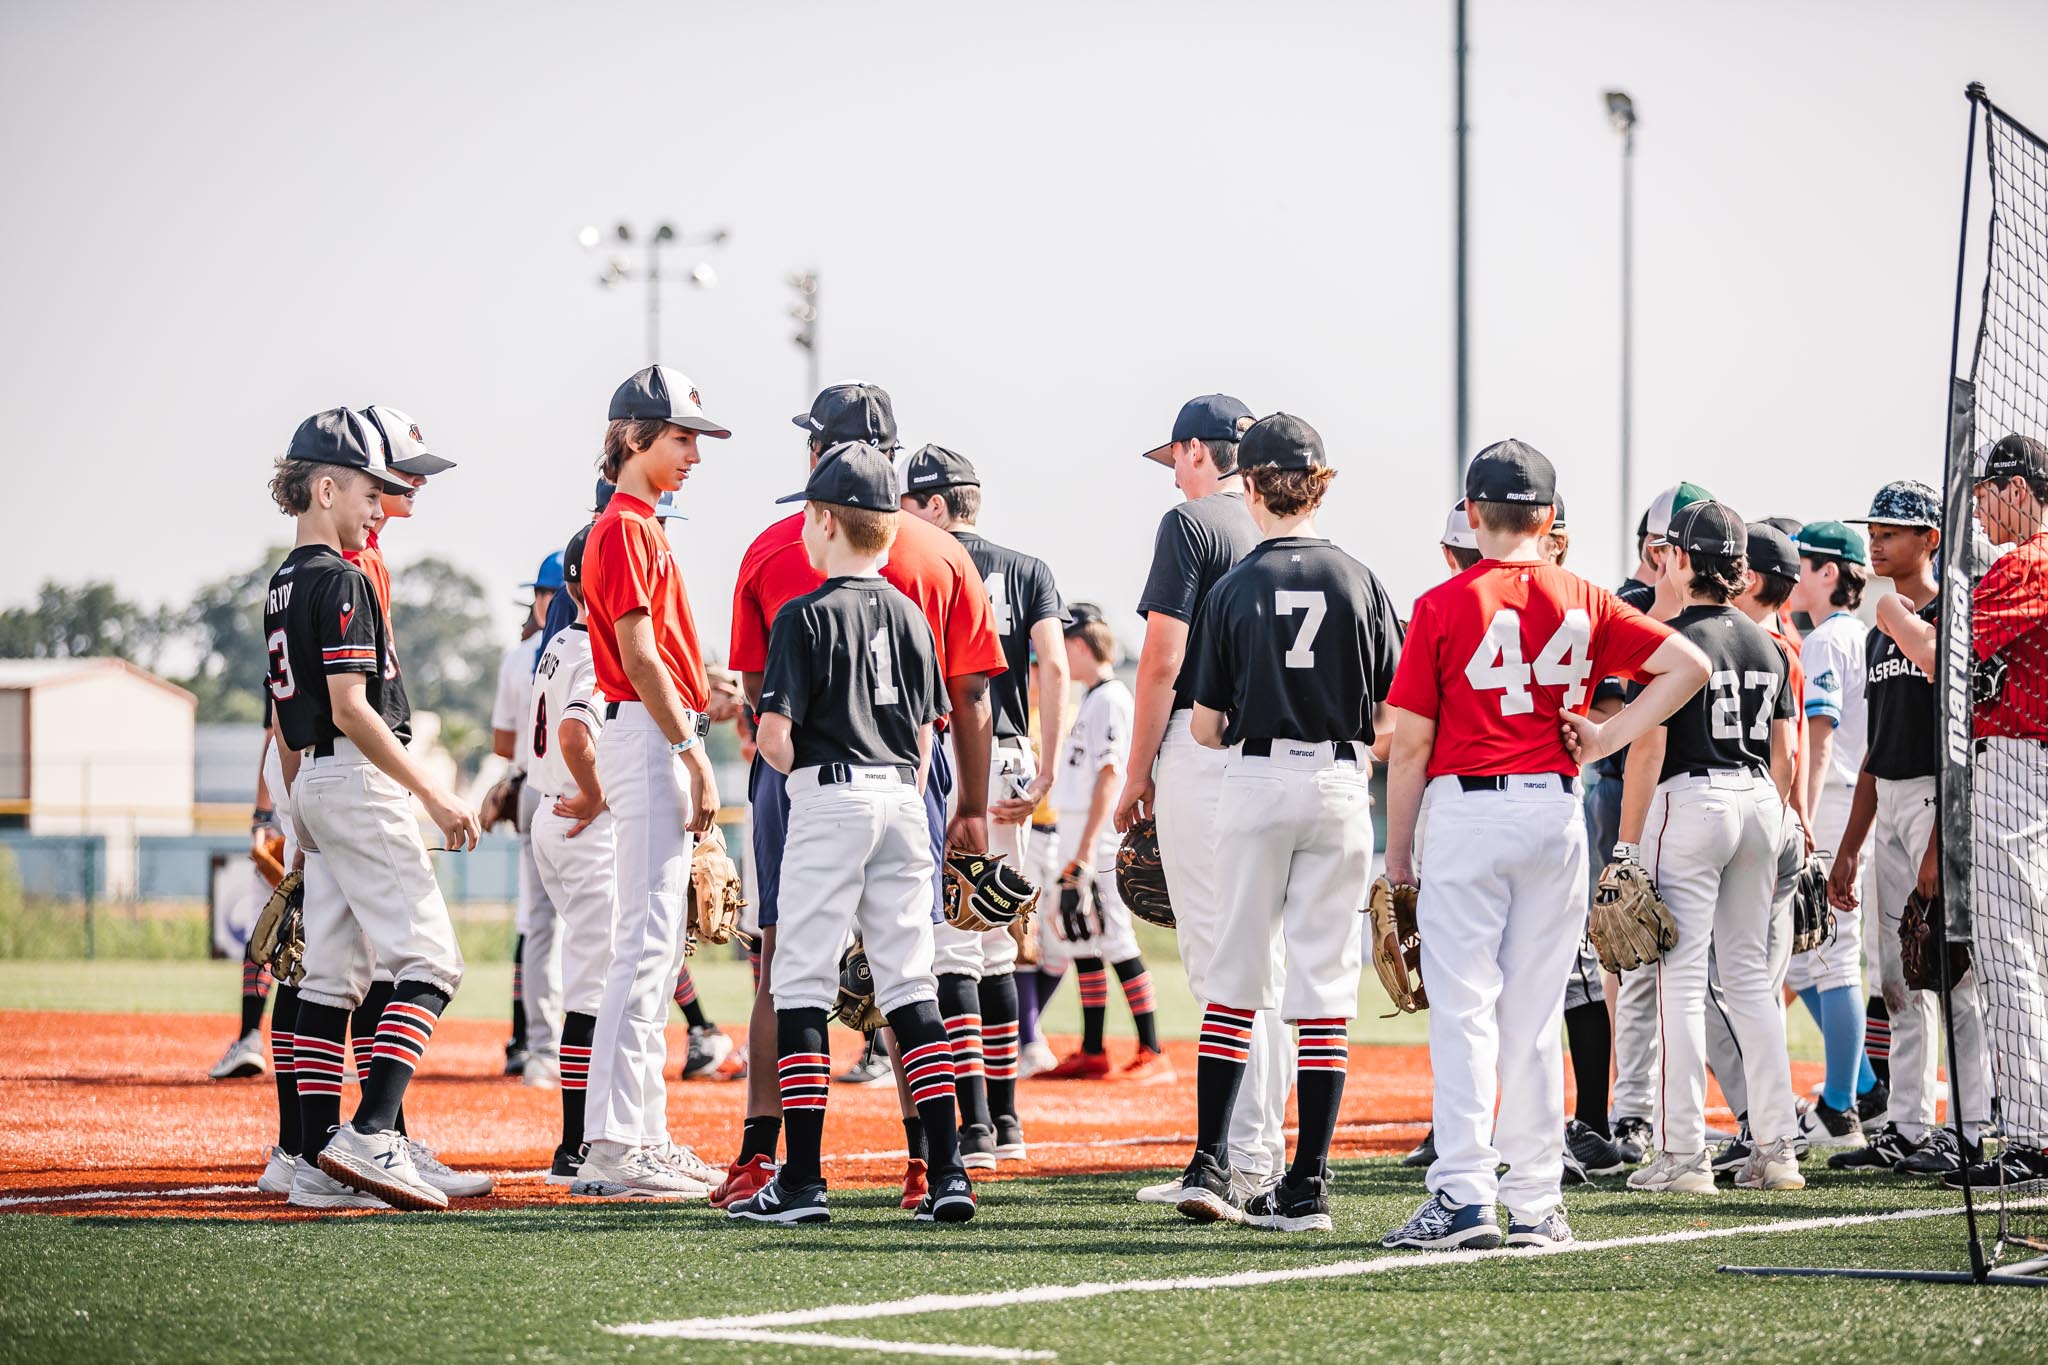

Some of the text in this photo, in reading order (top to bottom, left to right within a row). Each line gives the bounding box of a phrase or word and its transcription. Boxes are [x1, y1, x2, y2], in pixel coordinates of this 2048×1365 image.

[1303, 452, 1312, 466] 7
[1506, 491, 1537, 501] marucci
[570, 564, 577, 577] 8
[1722, 540, 1735, 556] 27
[267, 626, 297, 701] 3
[1275, 590, 1328, 669] 7
[1464, 608, 1594, 717] 44
[869, 627, 899, 706] 1
[1868, 657, 1929, 684] ASEBAL
[1948, 564, 1969, 767] marucci
[533, 691, 548, 759] 8
[1710, 670, 1779, 741] 27
[1289, 749, 1315, 757] marucci
